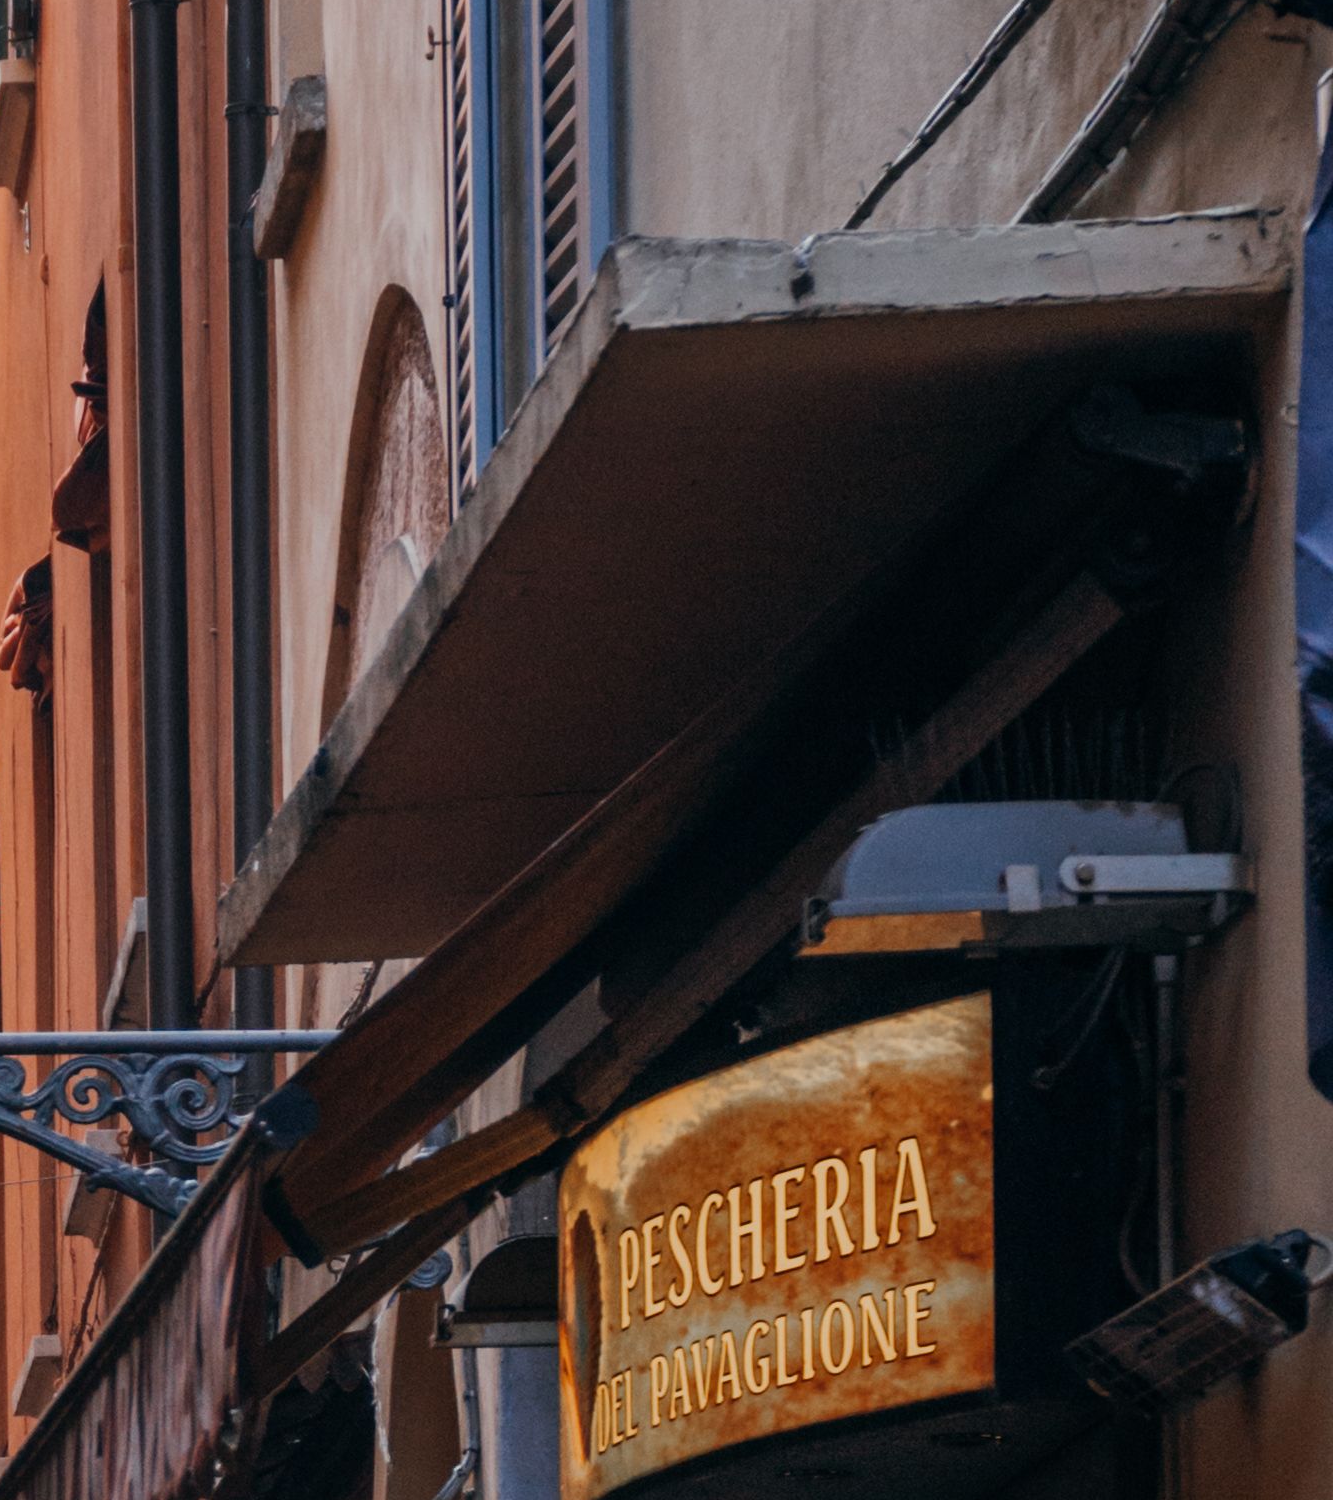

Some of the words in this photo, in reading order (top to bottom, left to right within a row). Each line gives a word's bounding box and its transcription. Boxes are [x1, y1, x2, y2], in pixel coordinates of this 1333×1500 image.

[619, 1137, 938, 1330] PESCHERIA
[596, 1367, 640, 1453] DEL
[650, 1280, 938, 1428] PAVAGLIONE
